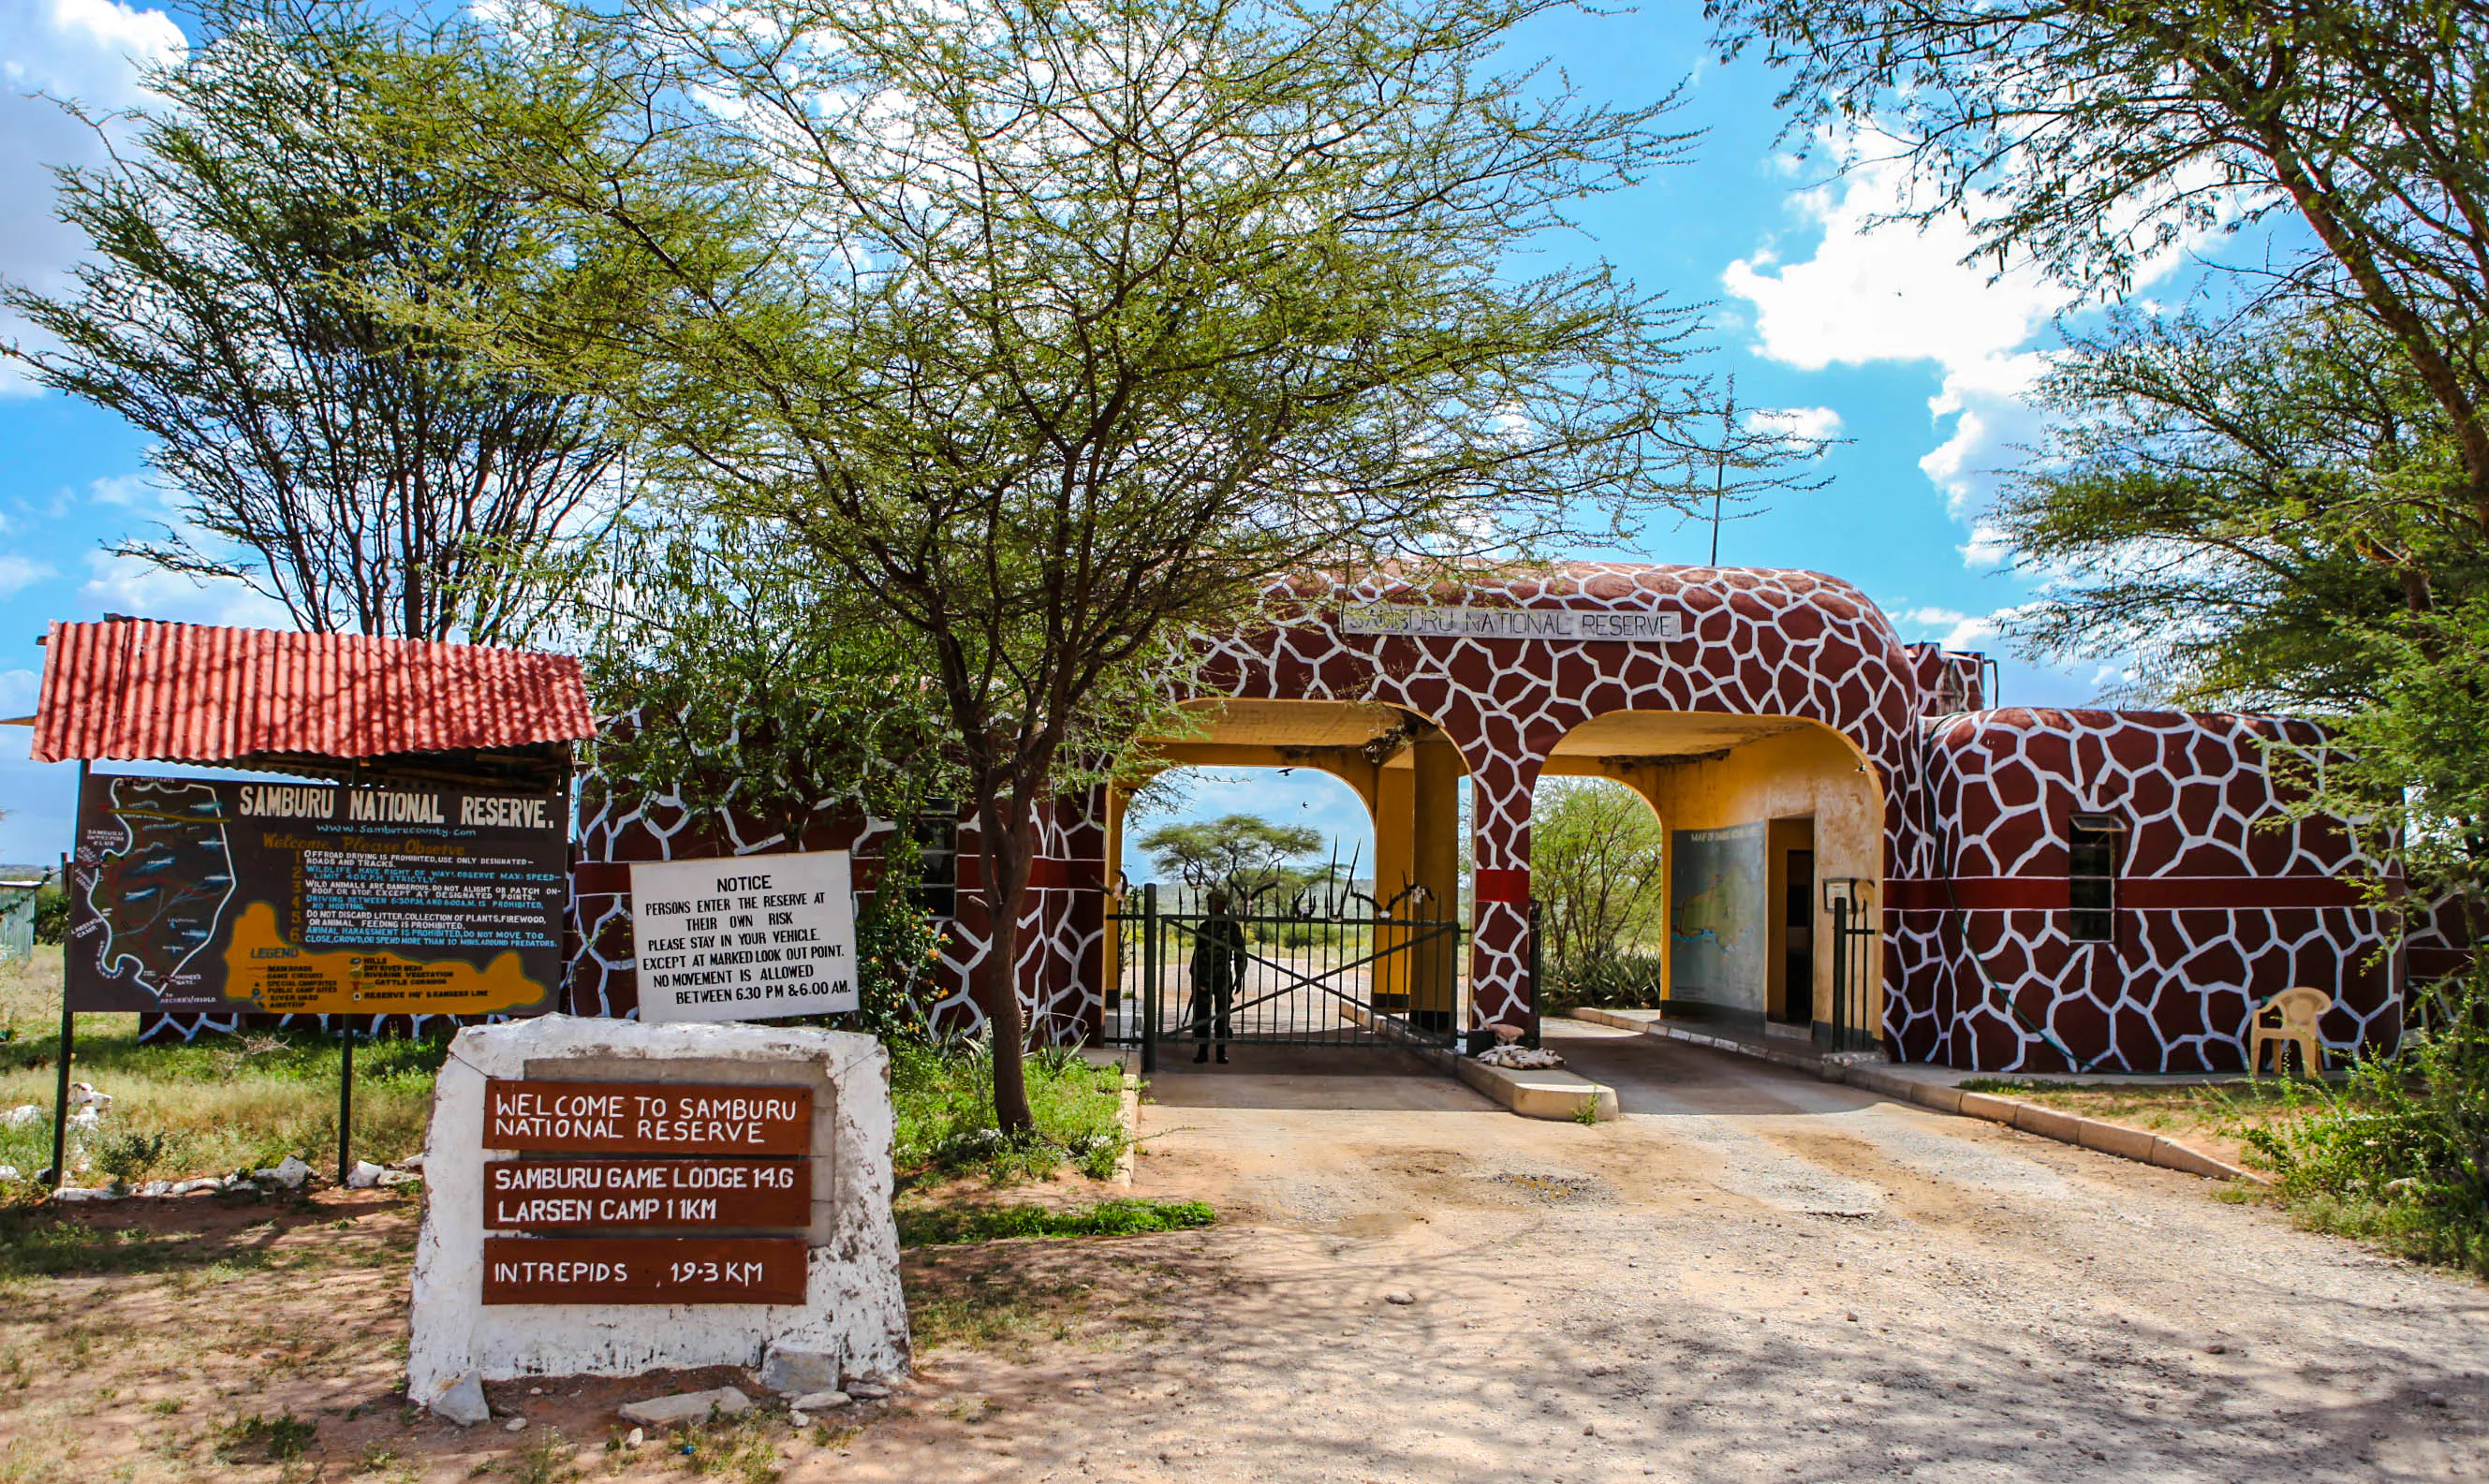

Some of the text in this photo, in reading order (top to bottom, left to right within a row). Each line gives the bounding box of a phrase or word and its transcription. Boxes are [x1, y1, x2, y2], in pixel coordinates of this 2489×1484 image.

[1465, 611, 1572, 636] NATIONAL
[1582, 614, 1672, 637] RESERVE
[240, 786, 553, 829] SAMBURU NATIONAL RESERVE.
[341, 836, 400, 854] Please
[405, 838, 464, 856] Observe
[346, 852, 377, 860] DRIVING
[306, 865, 351, 874] WILDLIFE
[384, 868, 410, 876] RIGHT
[358, 860, 396, 868] TRACKS.
[305, 879, 327, 888] WILD
[331, 881, 365, 889] ANIMALS
[510, 887, 540, 895] PATCH
[716, 874, 773, 892] NOTICE
[306, 894, 344, 904] DRIVING
[347, 896, 387, 904] BETWEEN
[435, 891, 493, 900] DESIGNATED
[645, 892, 826, 917] PERSONS ENTER THE RESERVE AT
[306, 909, 318, 918] DO
[405, 913, 452, 921] COLLECTION
[309, 918, 320, 926] OR
[411, 921, 465, 930] PROHIBITED.
[685, 912, 794, 932] THEIR OWN RISK
[306, 926, 337, 935] ANIMAL
[341, 927, 398, 936] HARASSMENT
[401, 928, 410, 936] IS
[525, 932, 544, 940] TOO
[376, 936, 400, 945] SPEND
[401, 936, 422, 945] MORE
[423, 937, 446, 946] THAN
[648, 937, 686, 952] PLEASE
[690, 934, 715, 949] STAY
[720, 933, 732, 948] IN
[738, 932, 767, 947] YOUR
[250, 948, 301, 960] LEGEND
[642, 944, 845, 971] EXCEPT AT MARKED LOOK OUT POINT.
[653, 963, 815, 989] NO MOVEMENT IS ALLOWED
[675, 988, 732, 1005] BETWEEN
[736, 986, 761, 1001] 6.30
[765, 984, 784, 999] PM
[831, 979, 851, 994] AM.
[495, 1093, 796, 1122] WELCOME TO SAMBURU
[494, 1118, 765, 1144] NATIONAL RESERVE
[494, 1168, 602, 1190] SAMBURU
[606, 1168, 667, 1189] GAME
[673, 1168, 747, 1189] LODGE
[498, 1199, 593, 1223] LARSEN
[600, 1199, 660, 1220] CAMP
[494, 1262, 628, 1283] INTREPIDS
[726, 1262, 763, 1288] KM
